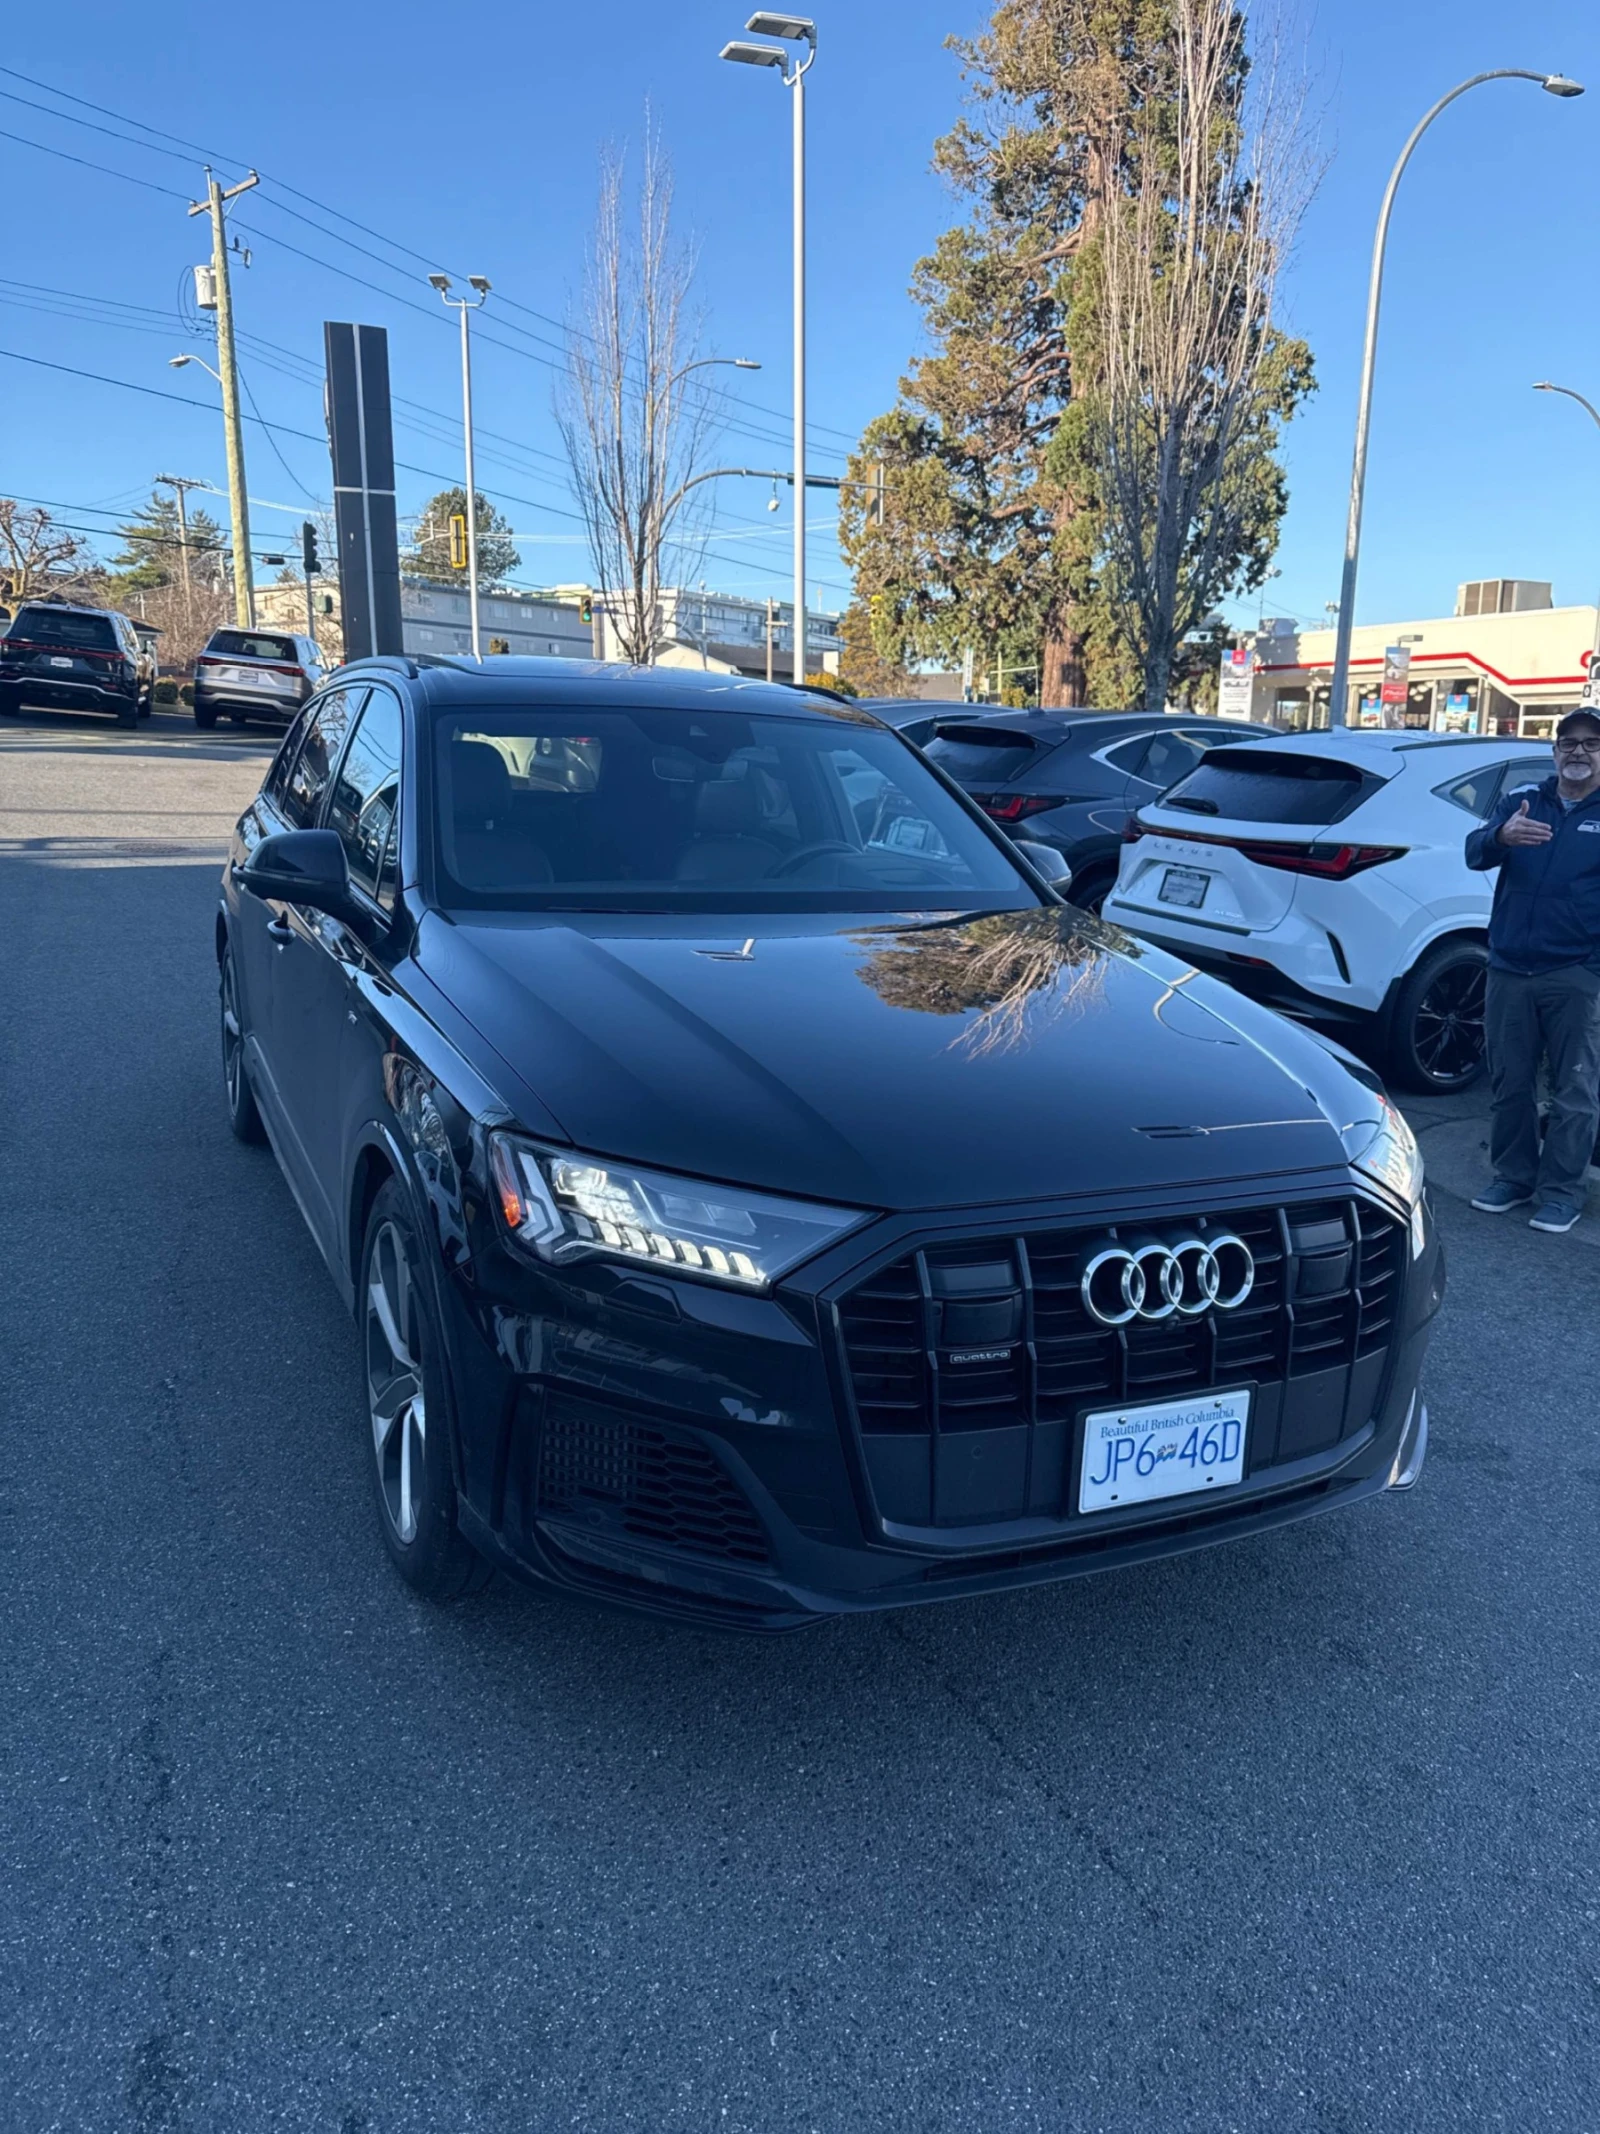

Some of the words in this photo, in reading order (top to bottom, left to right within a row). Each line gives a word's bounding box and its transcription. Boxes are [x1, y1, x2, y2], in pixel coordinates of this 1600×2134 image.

[1154, 842, 1214, 857] LEXUS
[953, 1351, 1009, 1363] quattro
[1100, 1422, 1149, 1439] Beautiful
[1151, 1415, 1184, 1431] British
[1185, 1407, 1235, 1425] Columbia
[1089, 1433, 1156, 1485] JP6
[1178, 1419, 1242, 1469] 46D
